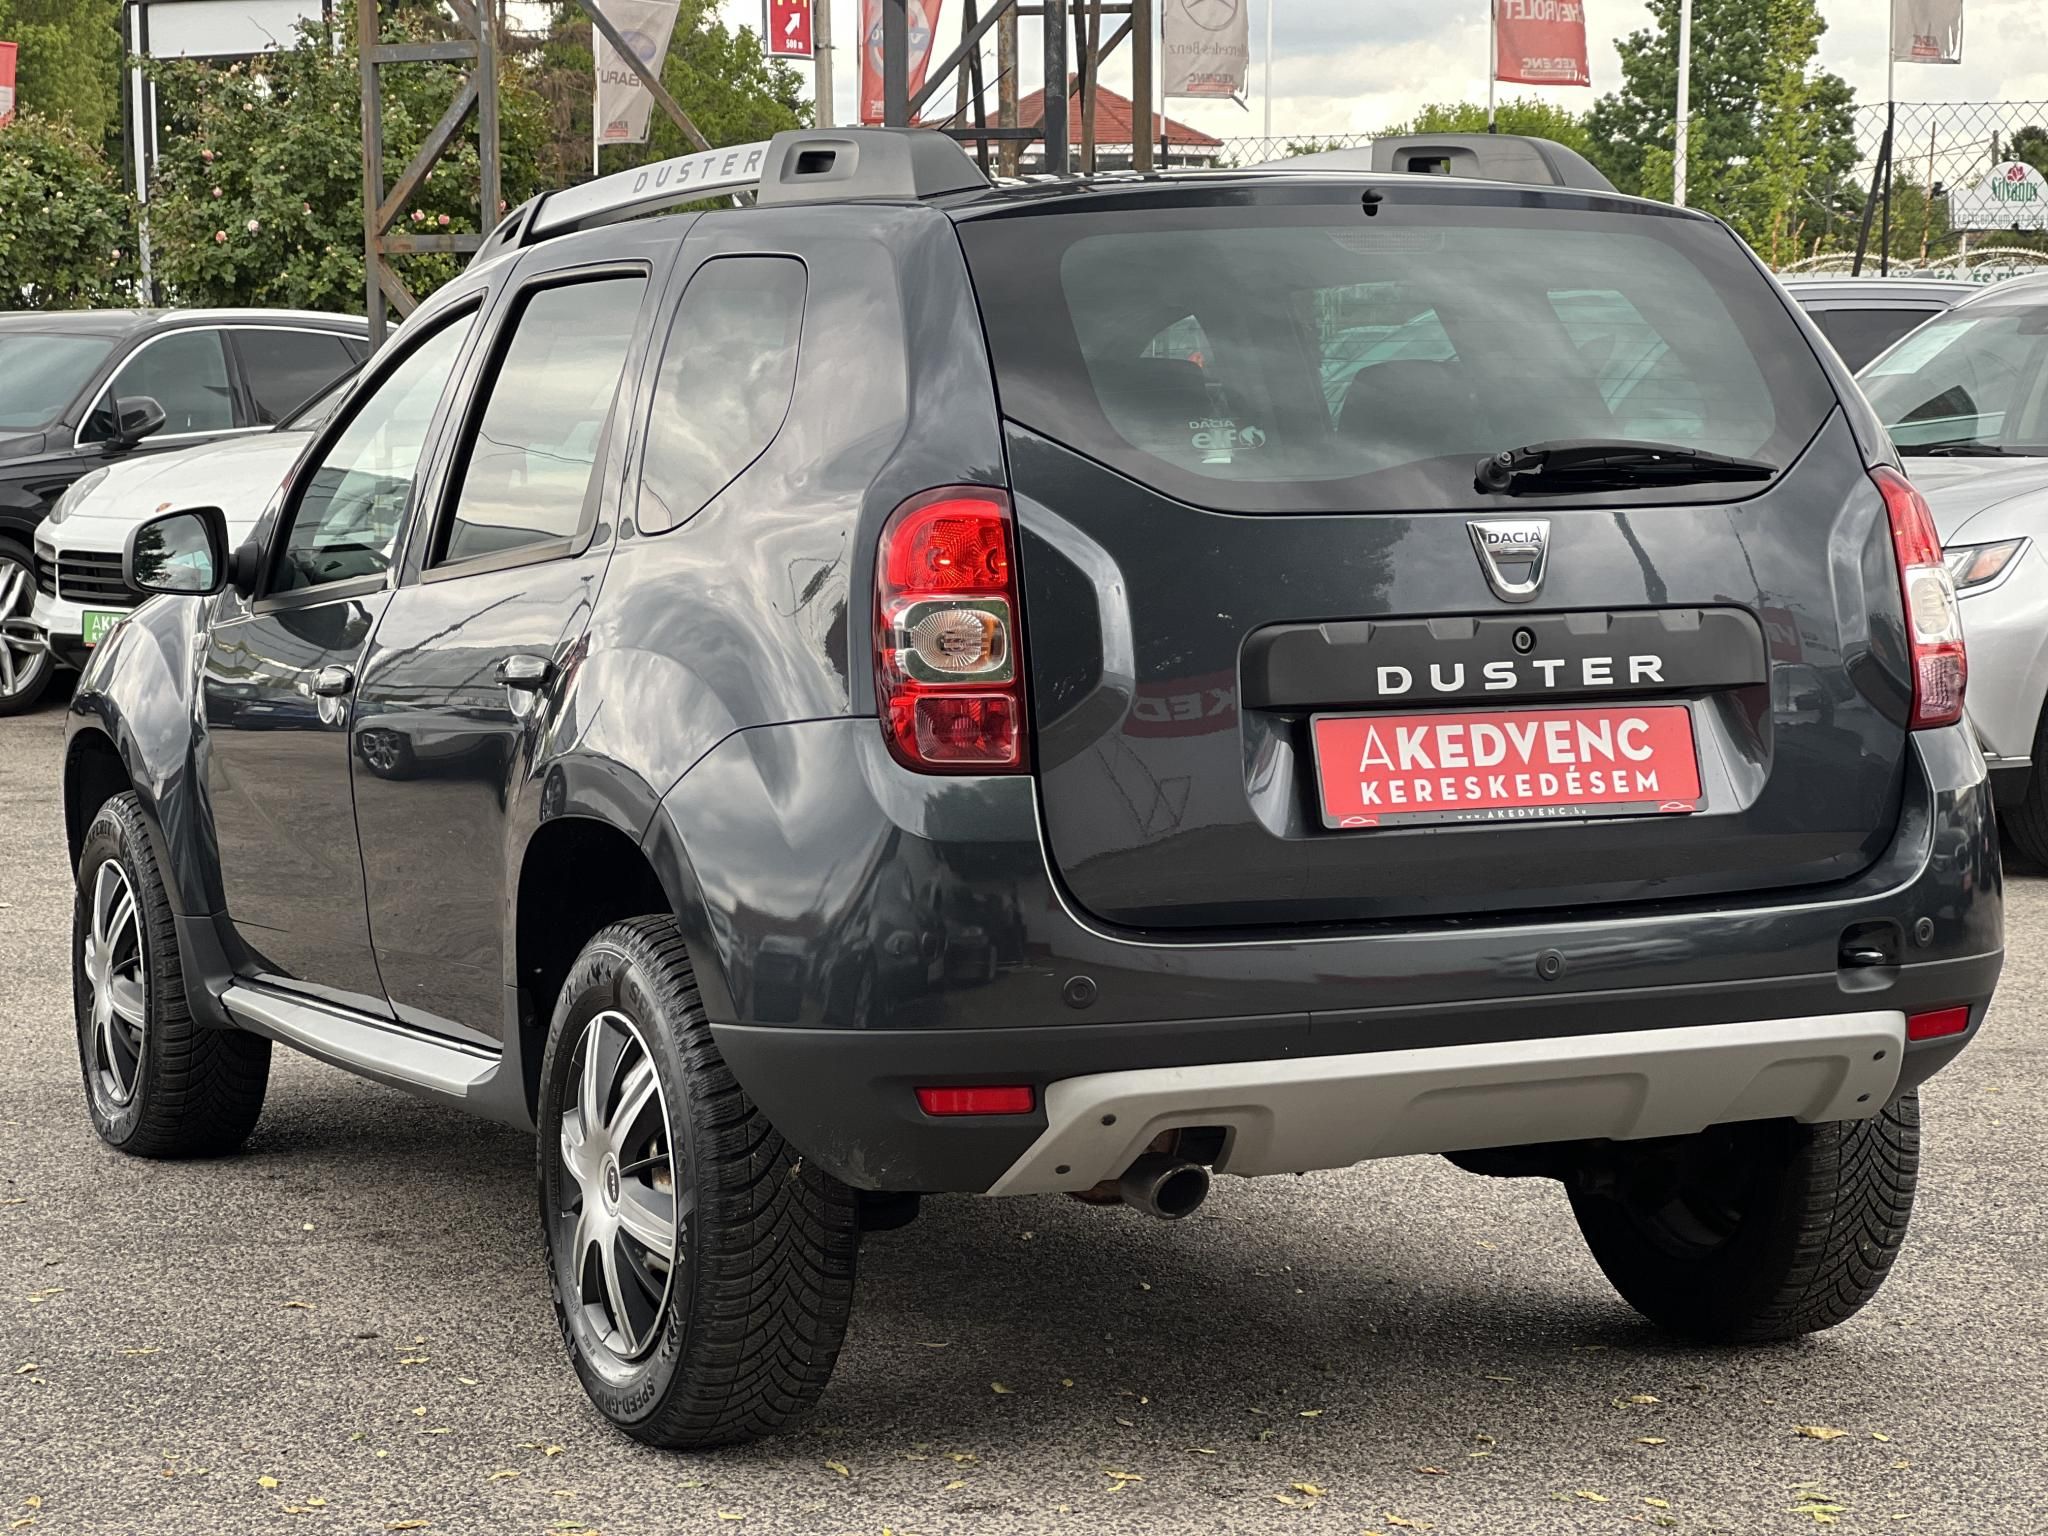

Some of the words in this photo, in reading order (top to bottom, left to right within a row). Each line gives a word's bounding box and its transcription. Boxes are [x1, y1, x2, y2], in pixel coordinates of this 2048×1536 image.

[633, 150, 762, 193] DUSTER
[1189, 420, 1236, 429] DACIA
[1487, 531, 1542, 545] DACIA
[1377, 655, 1665, 695] DUSTER
[1360, 765, 1660, 806] KERESKEDÉSEM
